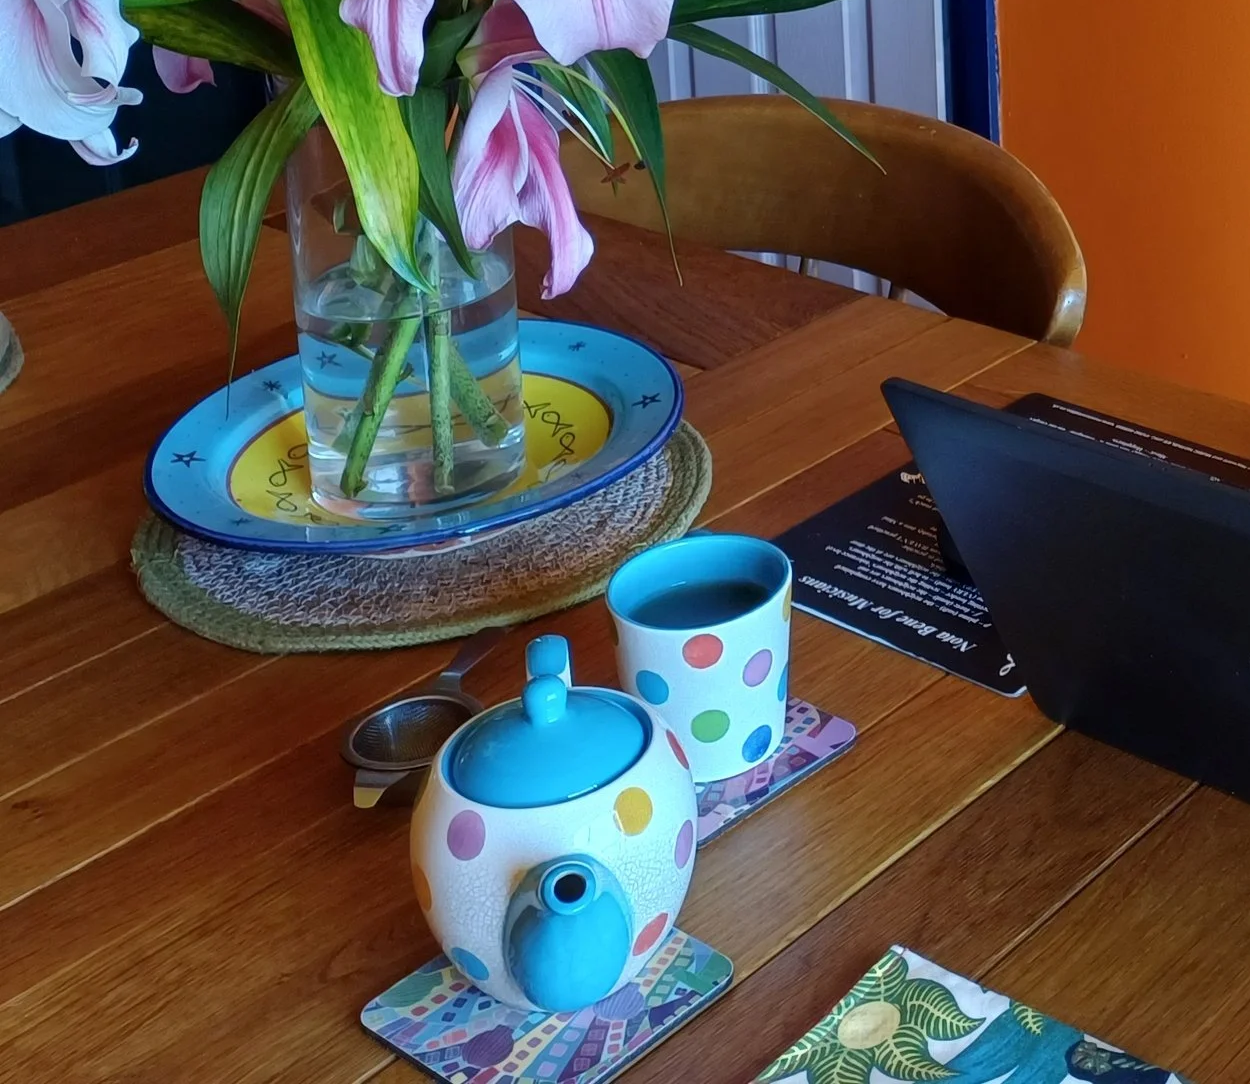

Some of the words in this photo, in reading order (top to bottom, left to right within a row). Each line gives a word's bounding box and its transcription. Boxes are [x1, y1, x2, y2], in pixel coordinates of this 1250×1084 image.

[798, 574, 875, 611] Musicians
[870, 605, 904, 620] for
[896, 615, 938, 637] Bene
[936, 631, 977, 653] Nota
